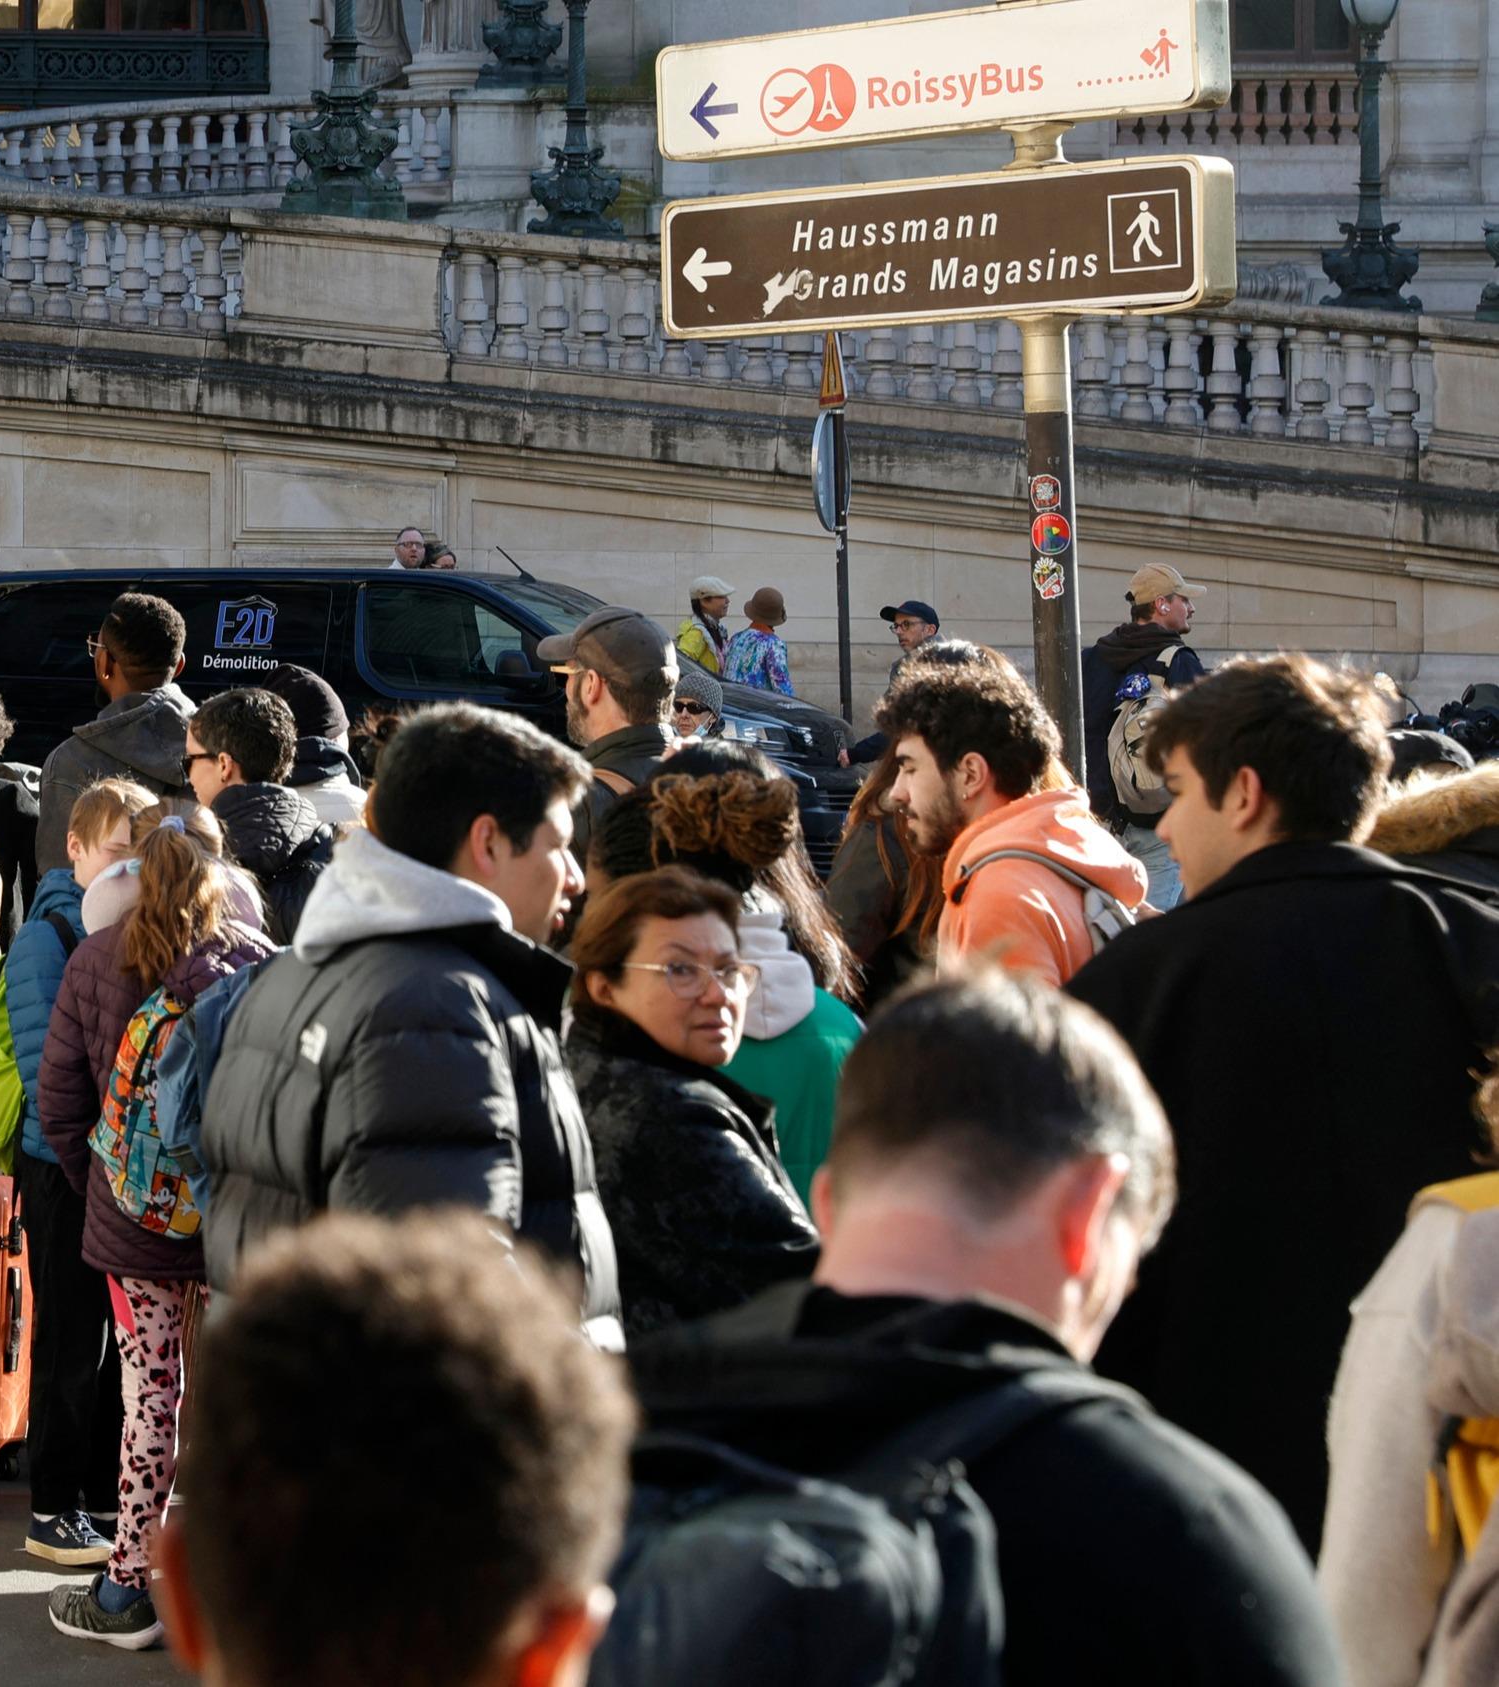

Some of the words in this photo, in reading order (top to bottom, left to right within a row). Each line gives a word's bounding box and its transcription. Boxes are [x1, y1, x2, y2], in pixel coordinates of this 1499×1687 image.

[867, 62, 1044, 110] RoissyBus
[792, 211, 999, 253] Haussmann
[794, 261, 907, 301] Grands
[929, 247, 1099, 294] Magasins
[214, 598, 276, 649] E2D
[202, 653, 279, 670] Démolition
